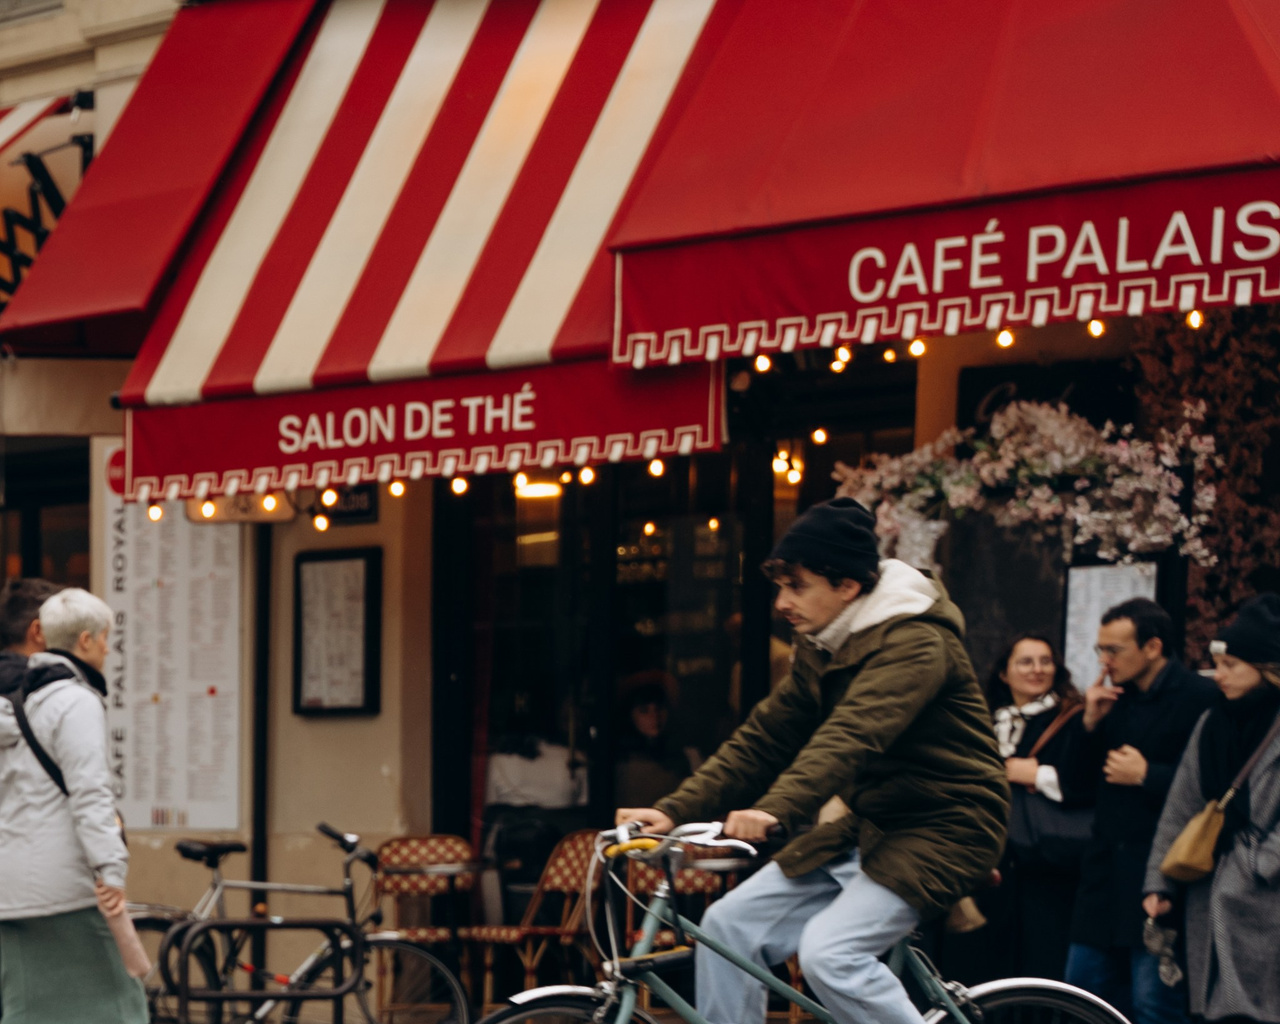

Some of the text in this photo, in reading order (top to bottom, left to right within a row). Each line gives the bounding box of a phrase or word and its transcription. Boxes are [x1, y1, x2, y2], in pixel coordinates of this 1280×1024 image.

[847, 200, 1280, 303] CAFÉ PALAIS
[278, 381, 537, 454] SALON DE THÉ
[112, 503, 128, 594] ROYAL
[112, 610, 127, 710] PALAIS
